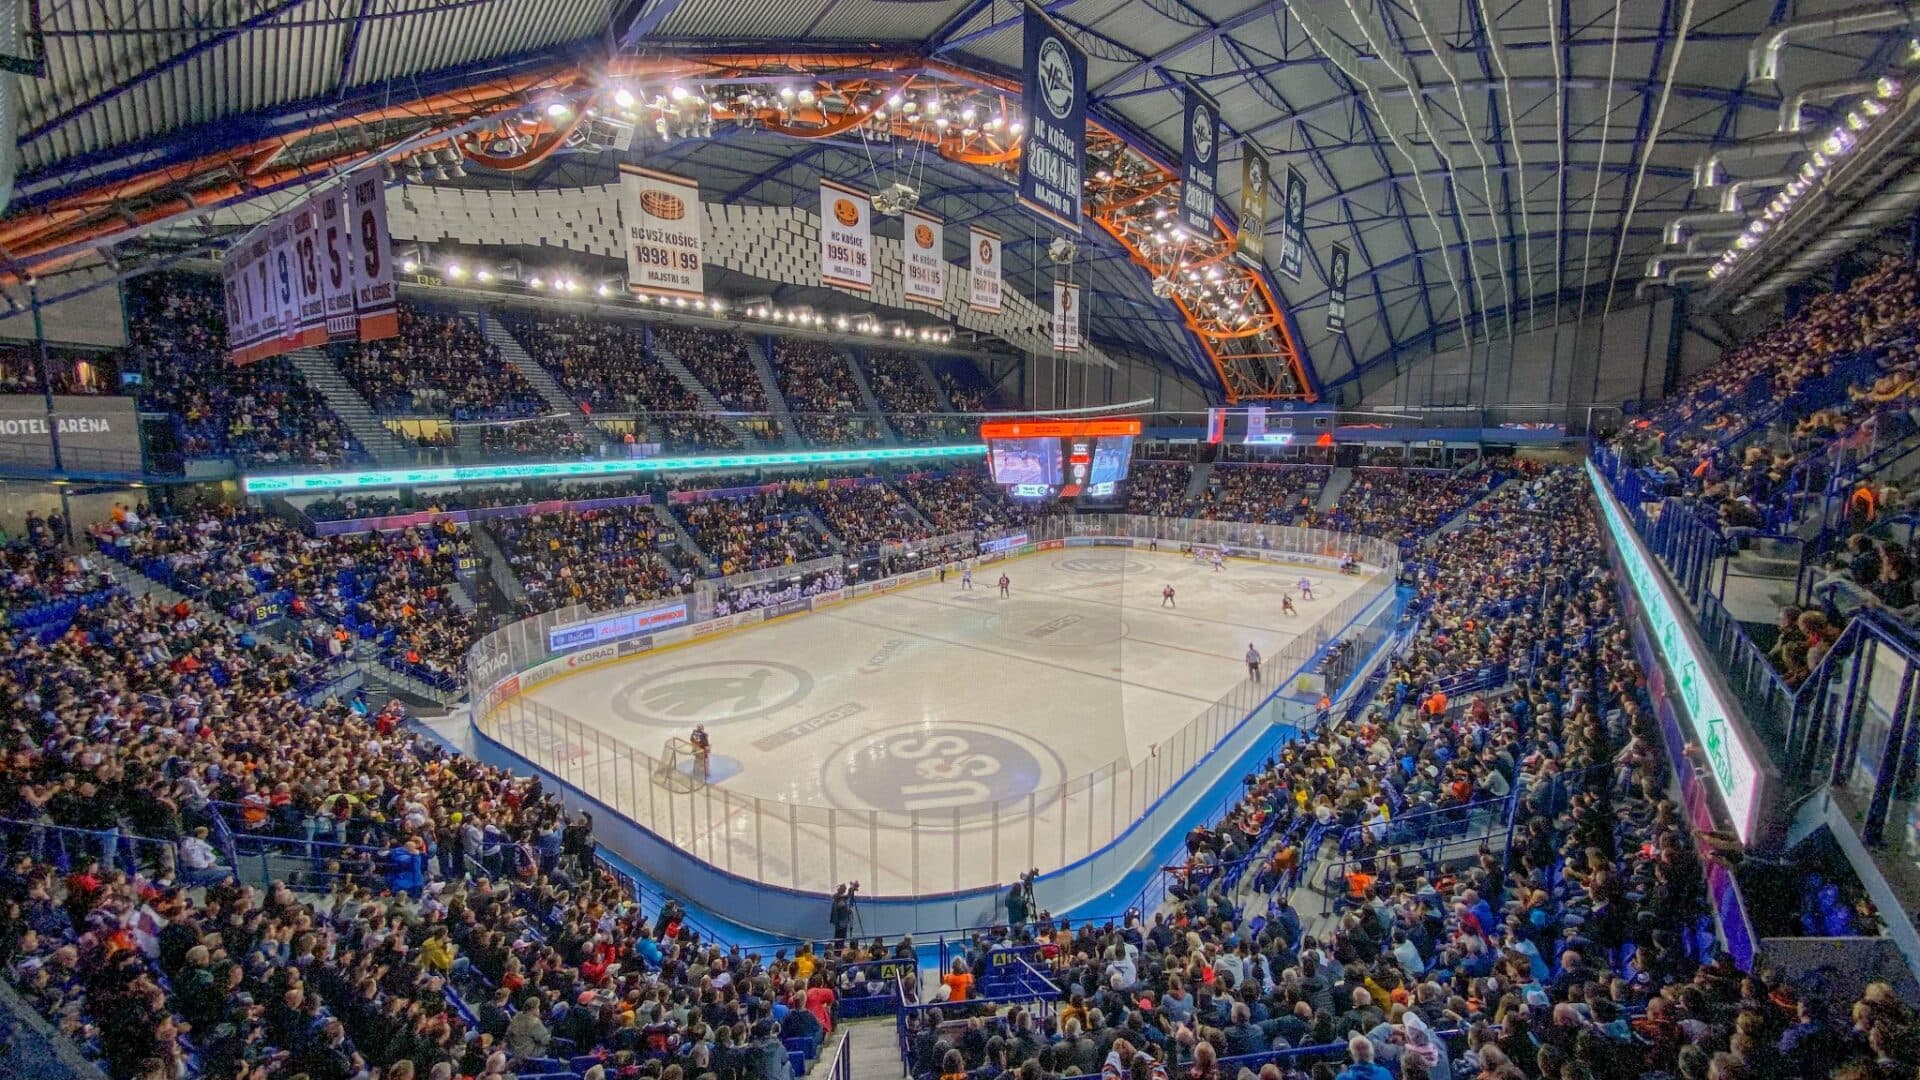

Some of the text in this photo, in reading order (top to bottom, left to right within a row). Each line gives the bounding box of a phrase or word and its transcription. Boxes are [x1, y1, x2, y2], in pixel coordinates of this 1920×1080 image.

[1034, 115, 1075, 159] HC KOŠICE
[1027, 138, 1059, 188] 2014
[361, 209, 380, 278] 9
[631, 227, 699, 249] HC VSŽ KOŠICE
[827, 244, 849, 262] 1995
[856, 251, 867, 266] 96
[831, 231, 862, 248] HC KOŠICE
[296, 236, 317, 297] 13
[327, 226, 342, 289] 5
[635, 245, 668, 266] 1998
[680, 252, 698, 270] 99
[258, 262, 267, 312] 7
[278, 251, 290, 304] 9
[648, 271, 690, 285] MAJSTRI SR
[58, 416, 111, 433] ARÉNA
[577, 648, 614, 664] KORAD
